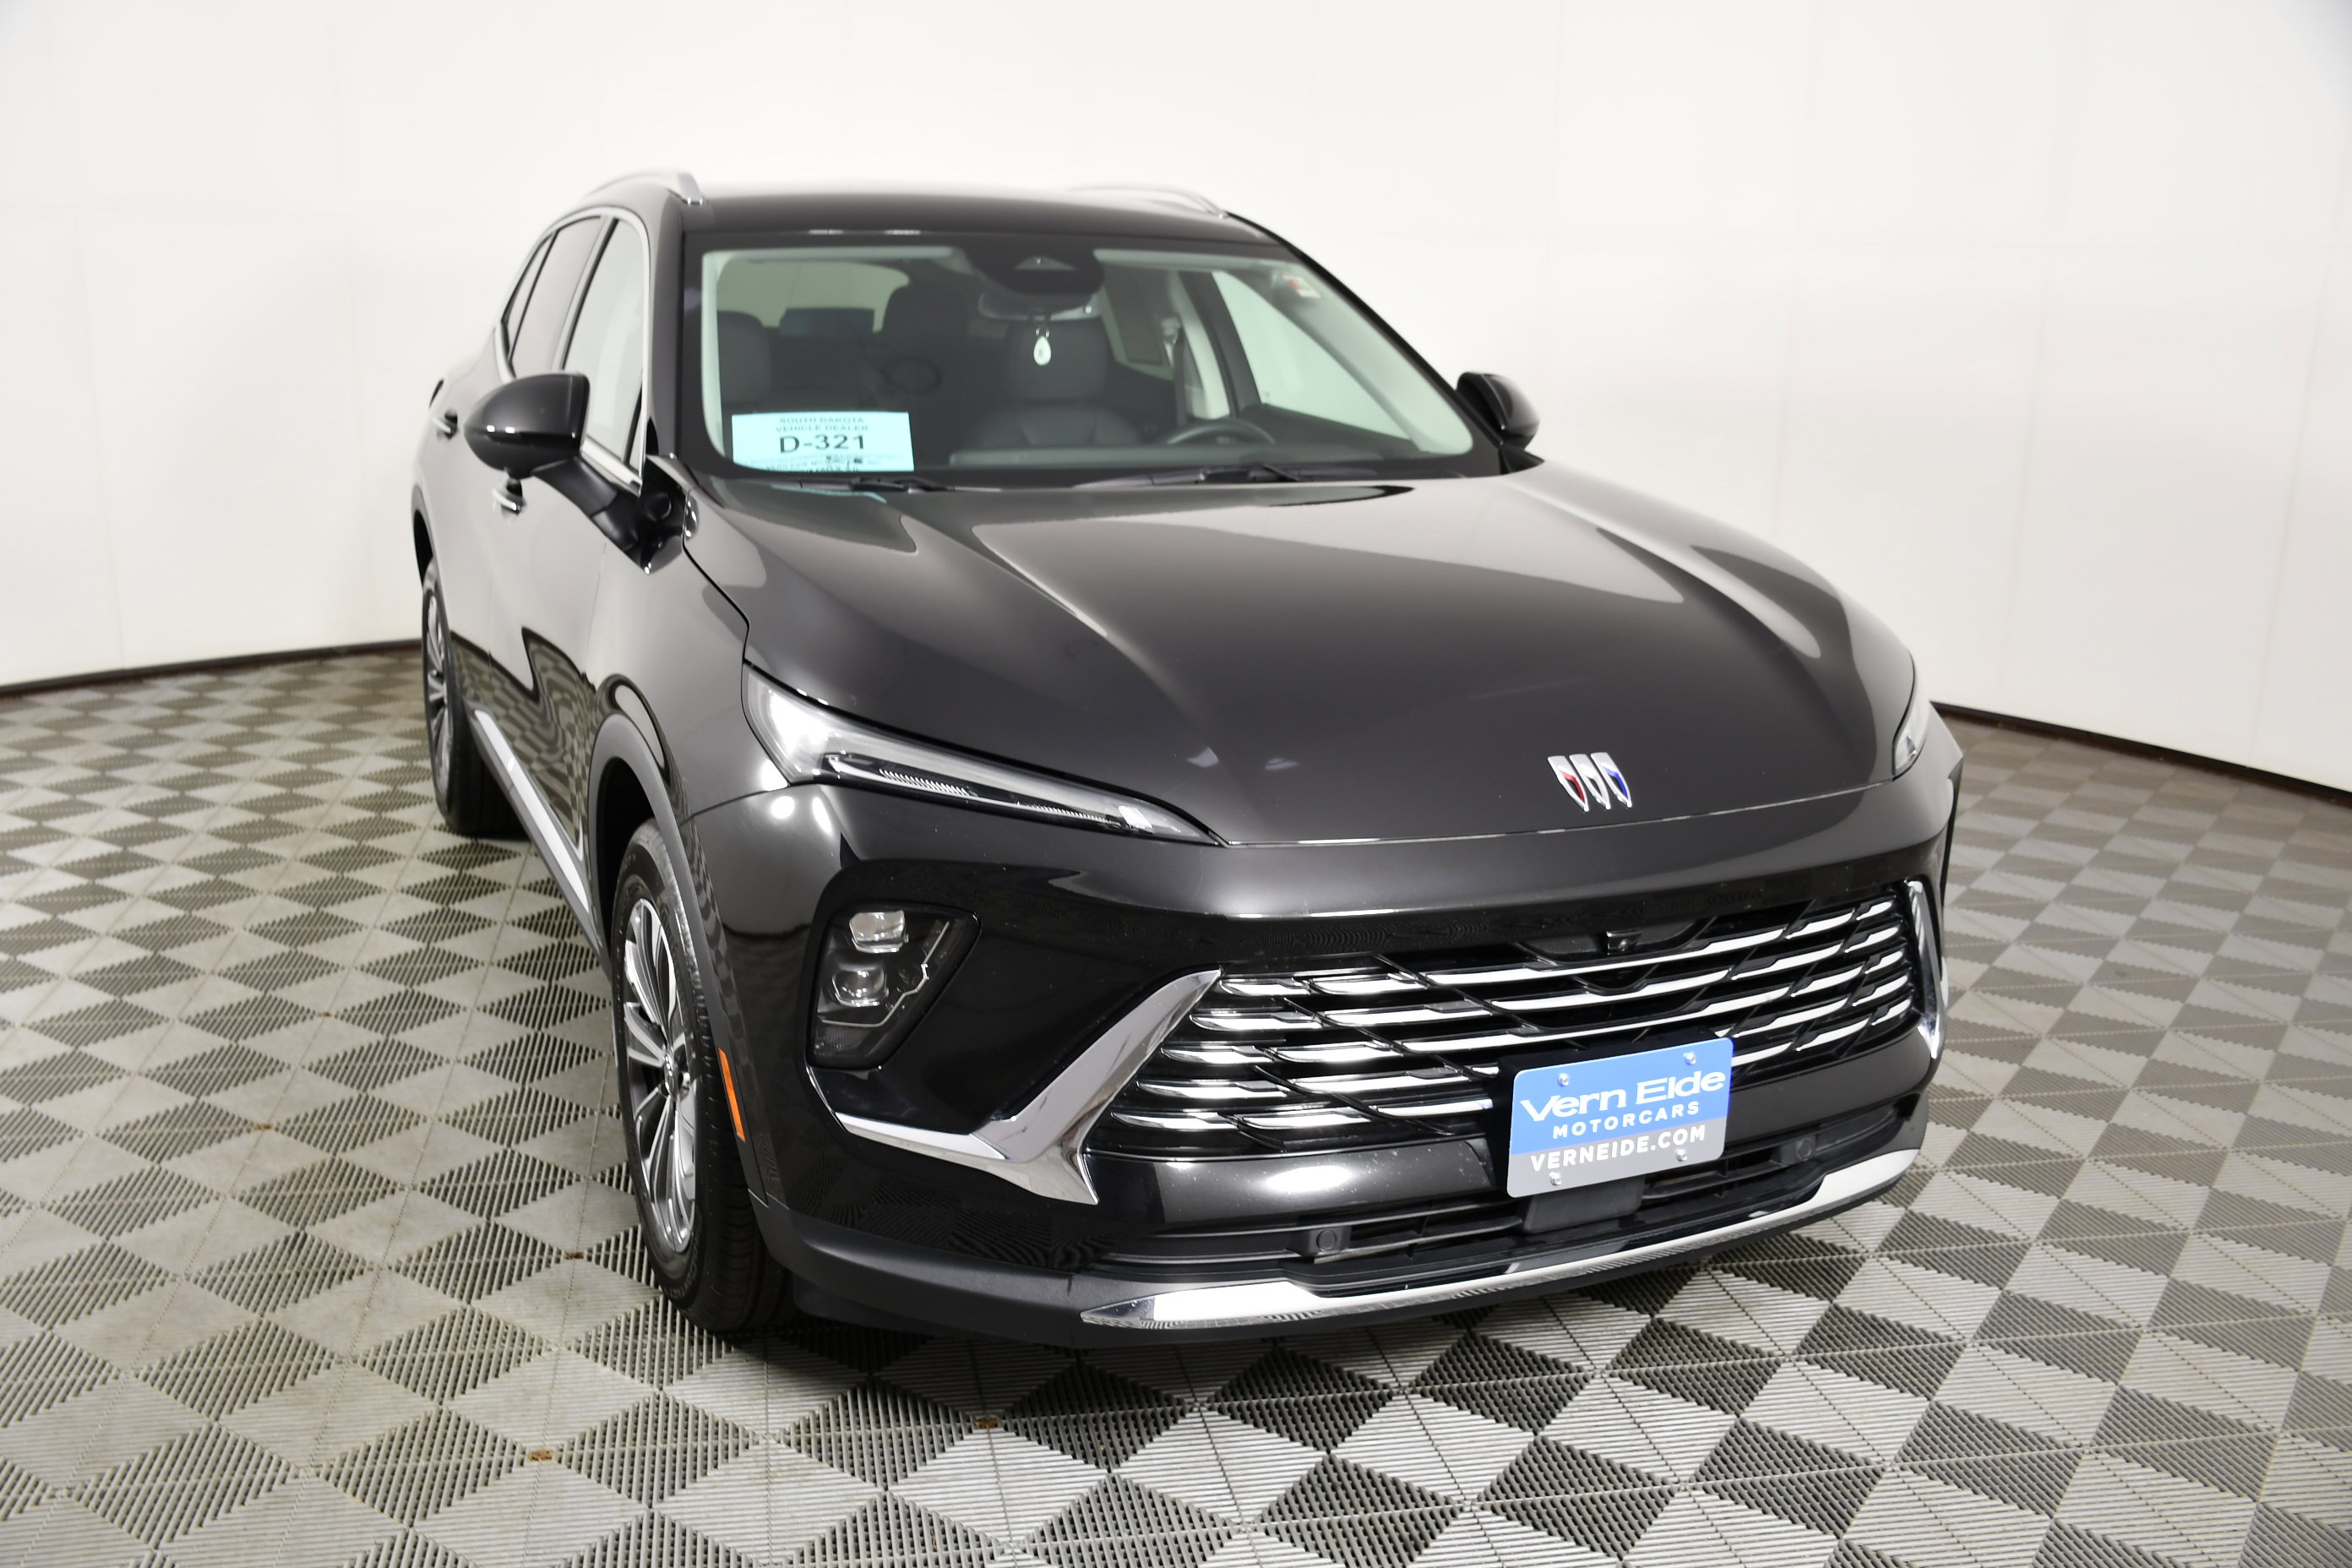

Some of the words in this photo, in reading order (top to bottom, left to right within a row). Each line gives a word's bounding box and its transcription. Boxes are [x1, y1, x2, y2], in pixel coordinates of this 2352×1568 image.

[779, 433, 864, 454] D-321
[1520, 1089, 1626, 1122] Vern
[1636, 1070, 1726, 1105] Eide
[1552, 1101, 1700, 1140] MOTORCARS
[1530, 1124, 1707, 1172] VERNEIDE.COM
